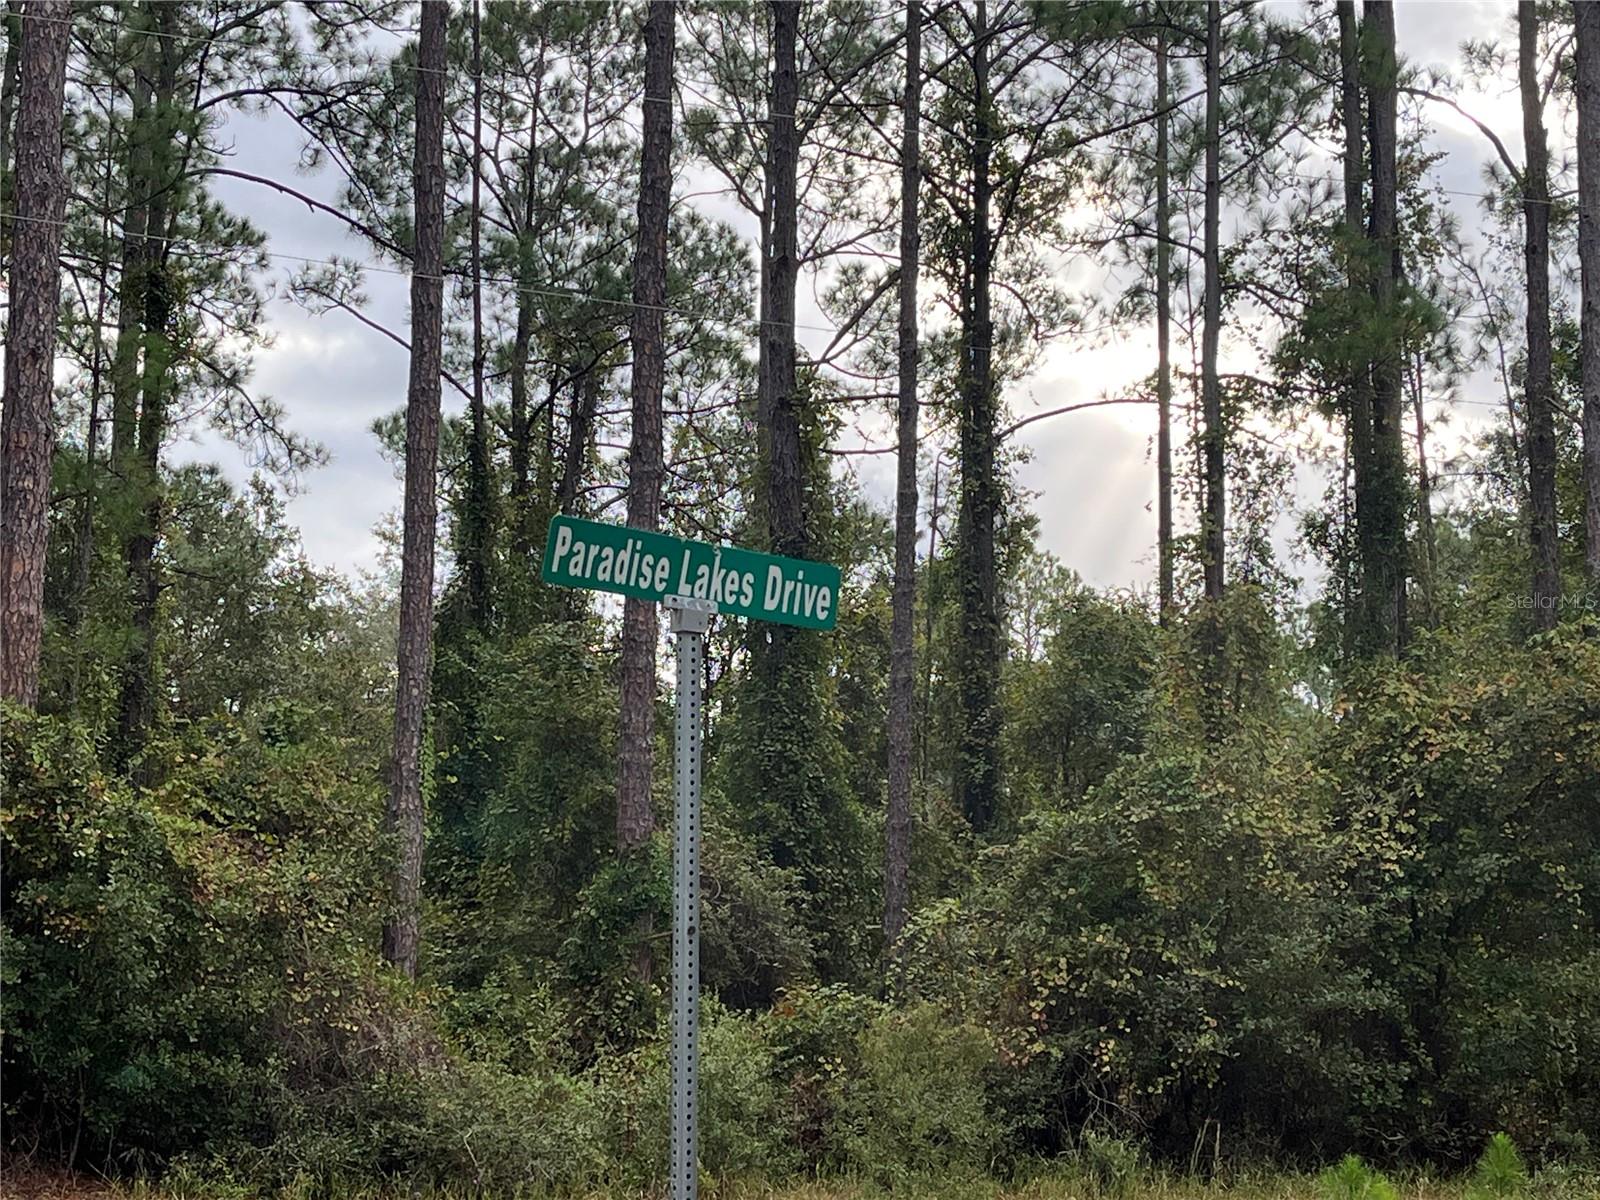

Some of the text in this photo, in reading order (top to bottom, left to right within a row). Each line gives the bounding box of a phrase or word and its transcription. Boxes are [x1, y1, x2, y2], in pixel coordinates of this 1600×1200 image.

[552, 526, 831, 620] Paradise Lakes Drive
